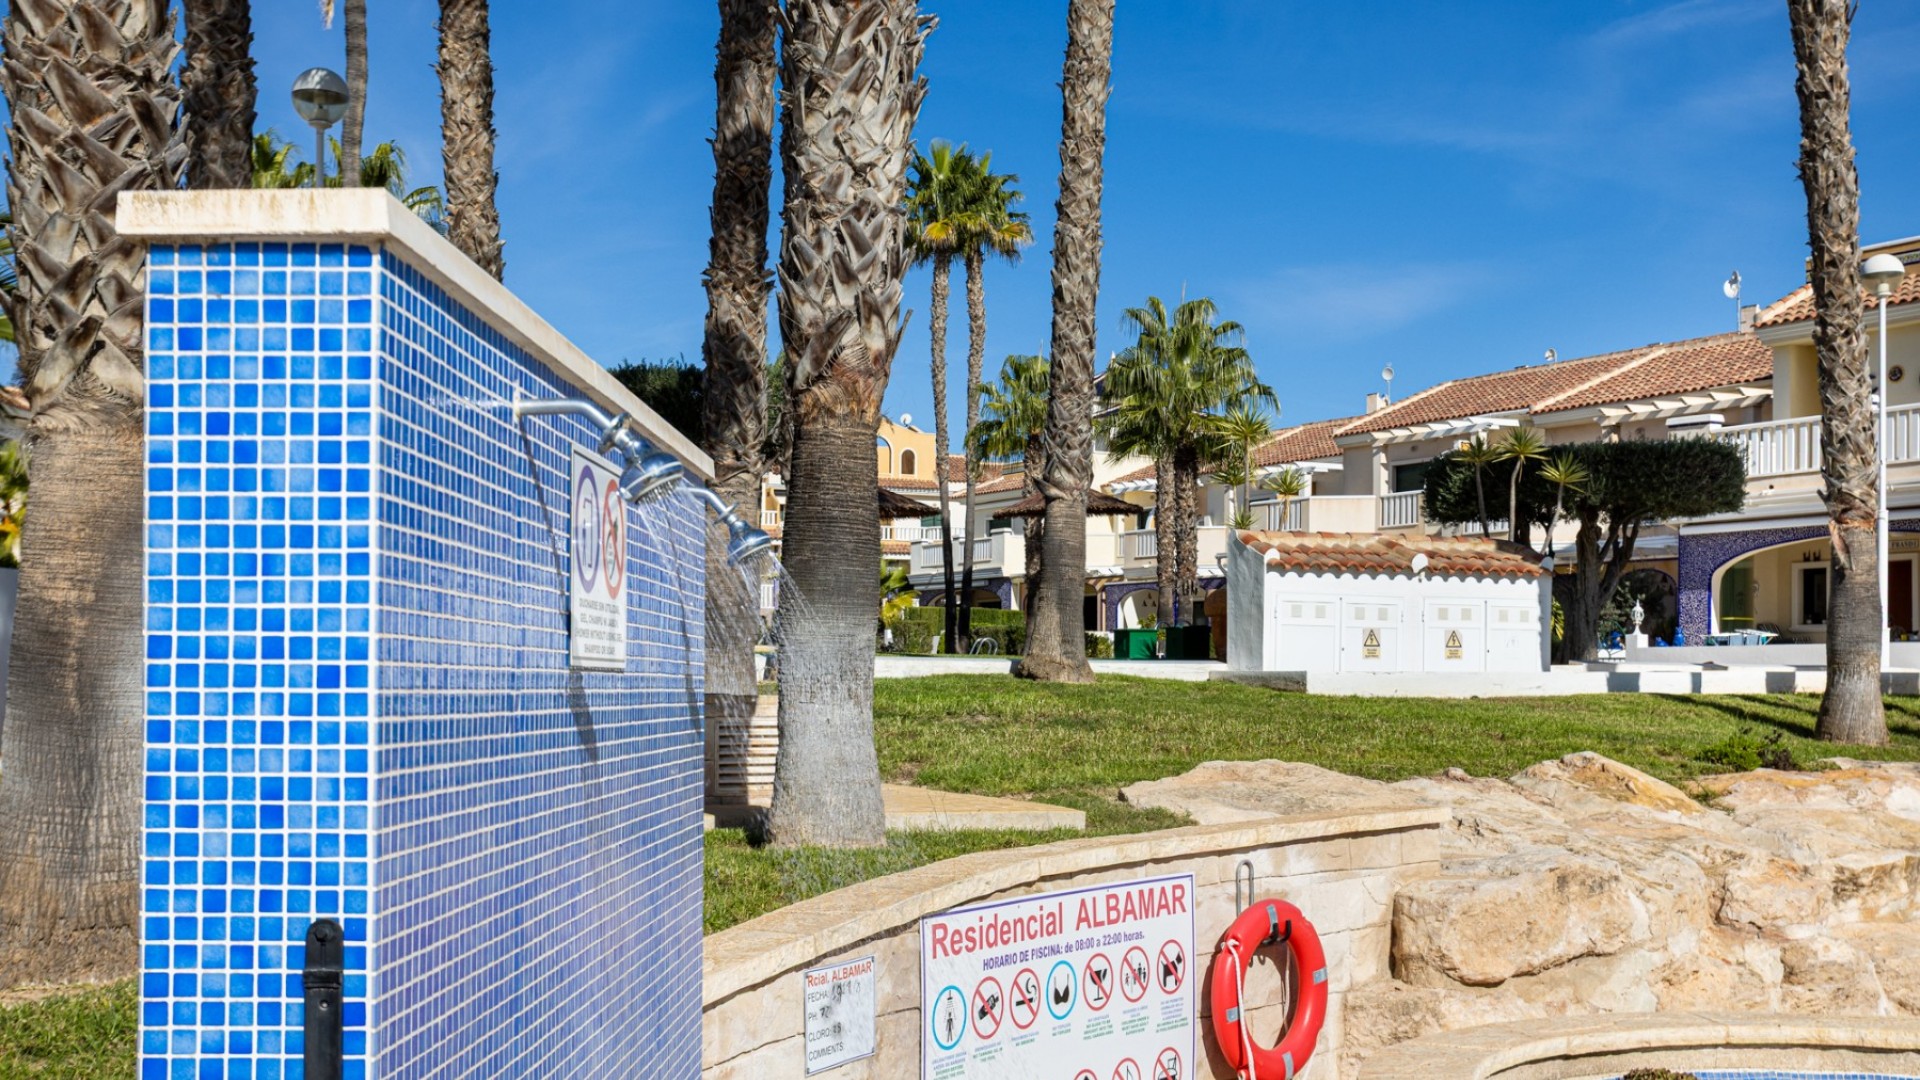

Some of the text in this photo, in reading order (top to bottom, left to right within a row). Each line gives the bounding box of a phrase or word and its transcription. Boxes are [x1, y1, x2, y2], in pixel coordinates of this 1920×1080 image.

[931, 883, 1187, 959] Residencial ALBAMAR
[983, 930, 1145, 971] HORARIO DE PISCINA: de 08:00 a 22:00 horas.
[807, 961, 872, 987] Rcial. ALBAMAR
